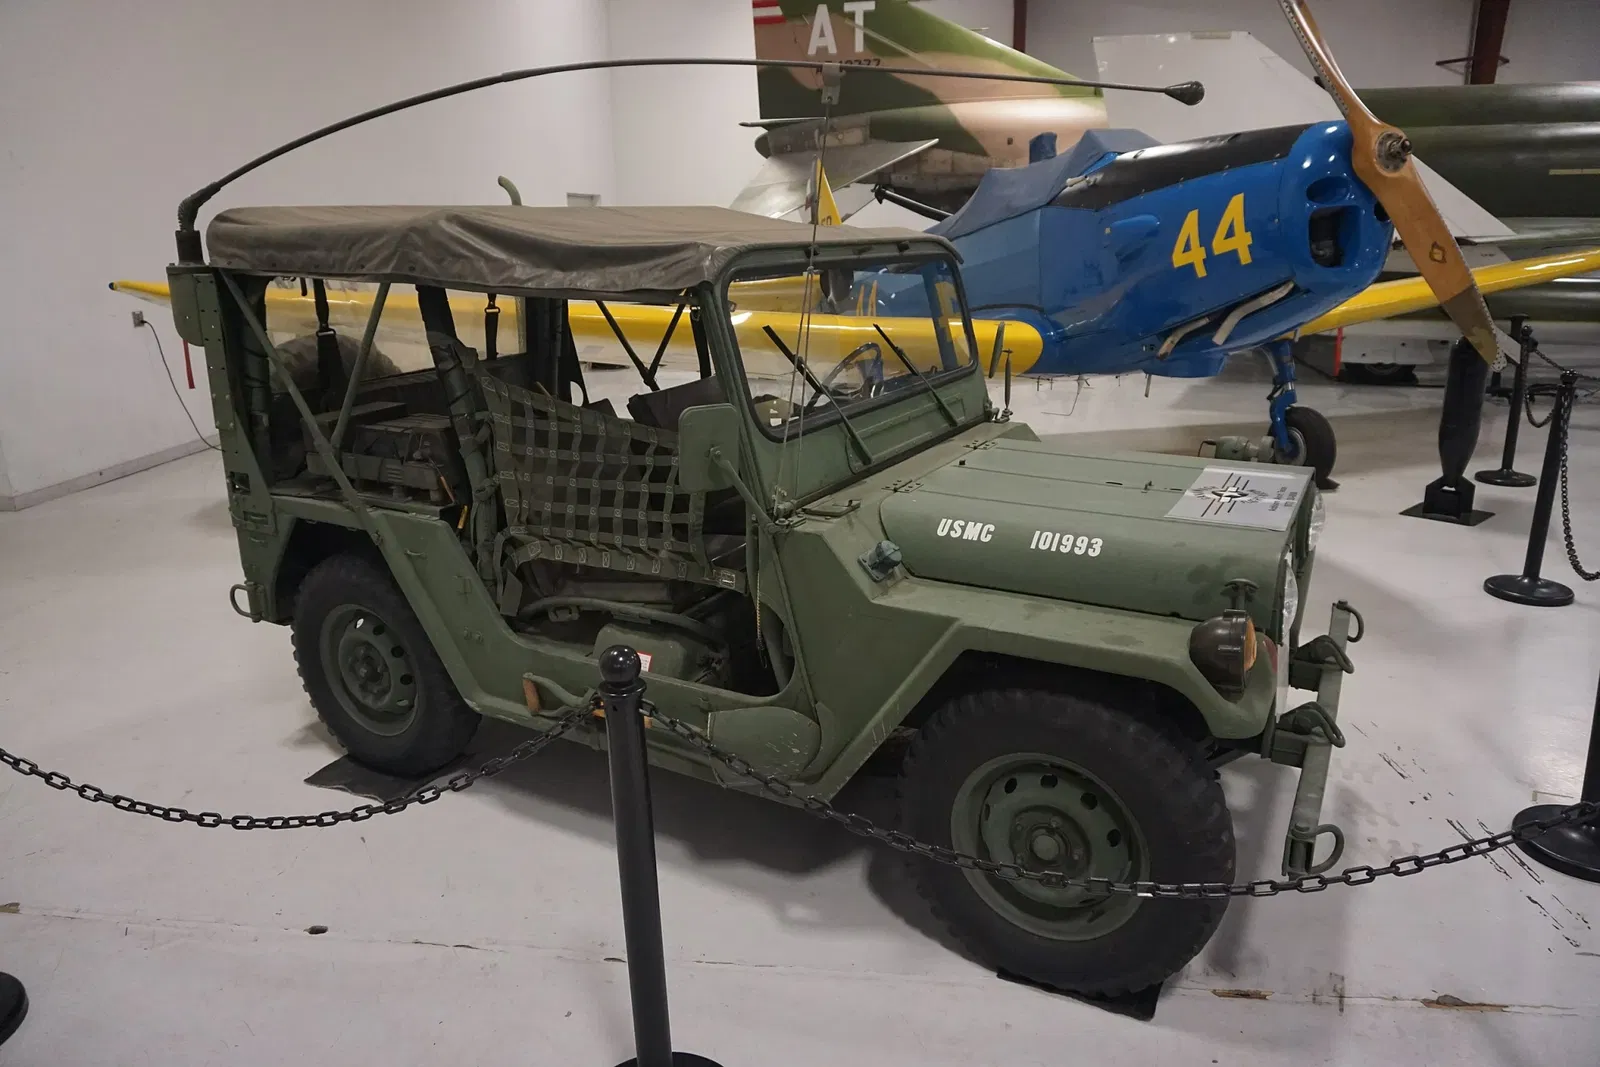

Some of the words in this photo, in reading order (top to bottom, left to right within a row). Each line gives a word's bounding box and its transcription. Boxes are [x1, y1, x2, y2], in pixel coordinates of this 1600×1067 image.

[807, 1, 876, 55] AT
[1172, 192, 1253, 278] 44
[936, 518, 995, 543] USMC
[1030, 530, 1103, 557] 101993
